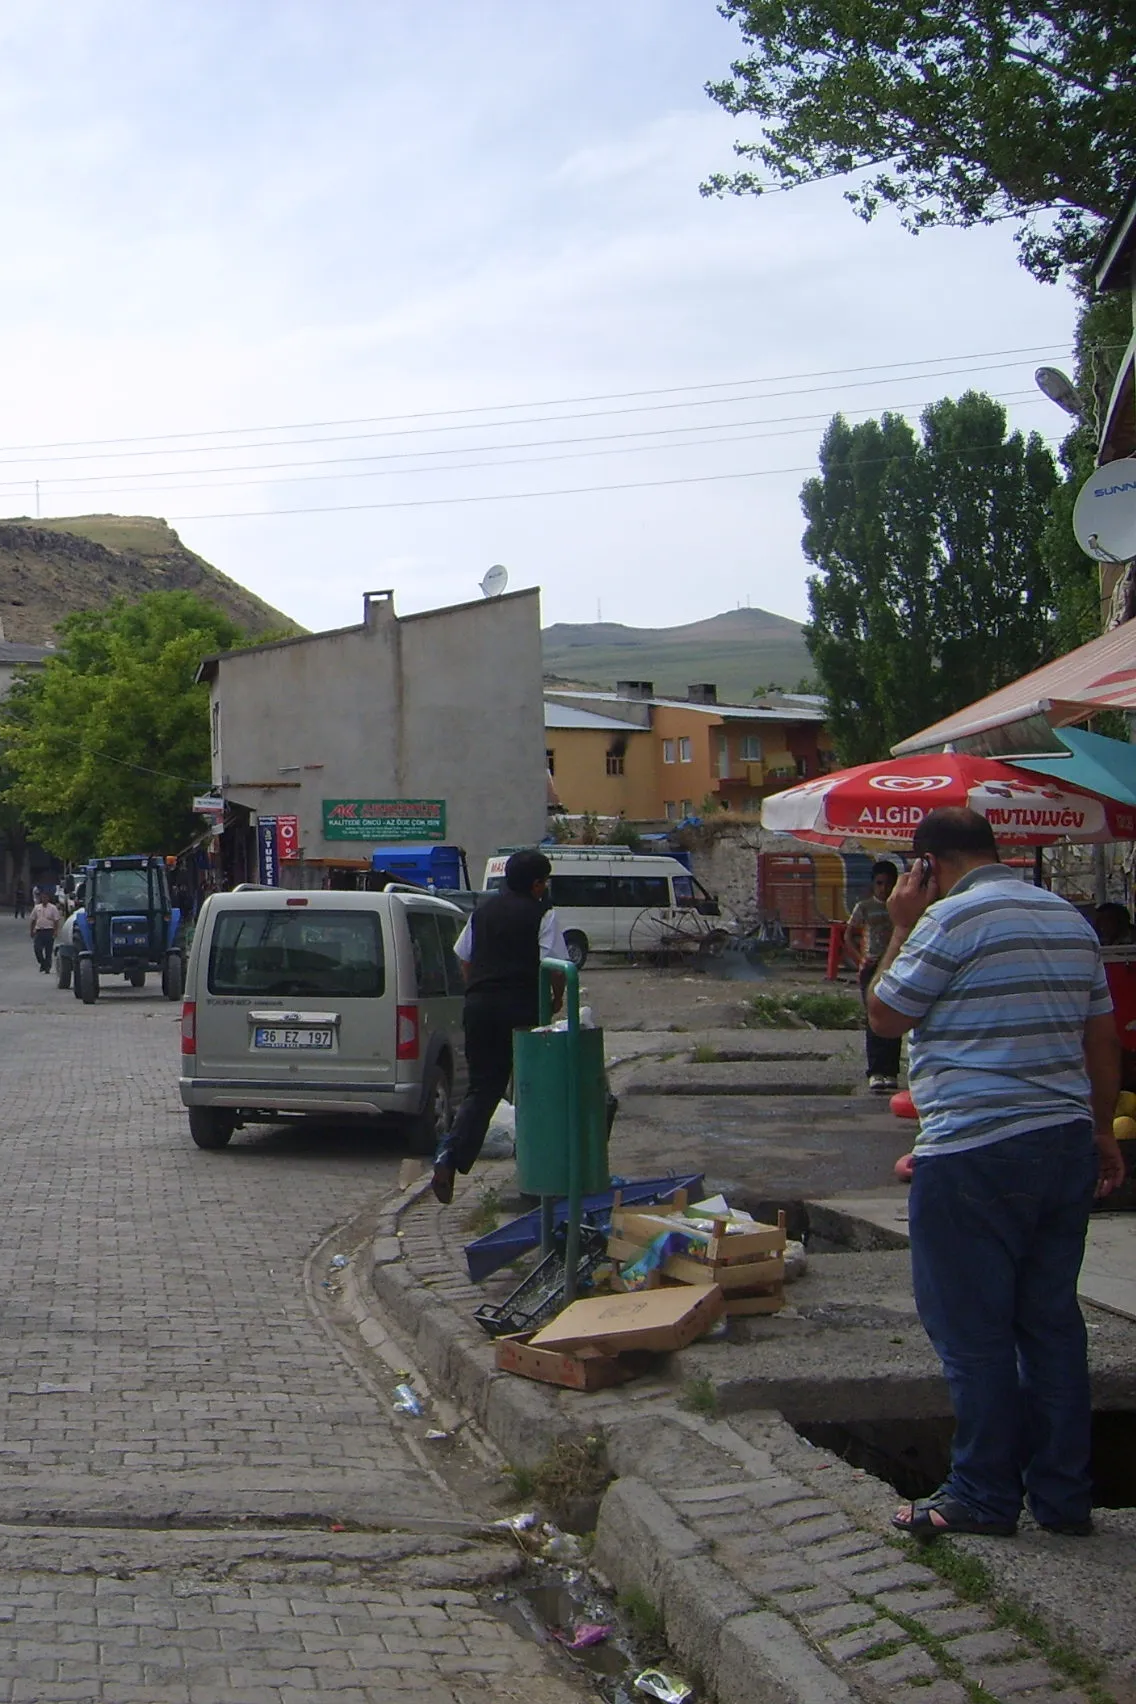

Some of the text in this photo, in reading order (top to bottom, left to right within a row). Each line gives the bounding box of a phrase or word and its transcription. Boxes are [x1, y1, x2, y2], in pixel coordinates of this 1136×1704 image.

[858, 806, 933, 824] ALGiD
[985, 807, 1085, 828] MUTLULUĞU
[262, 1031, 329, 1044] 36 EZ 197
